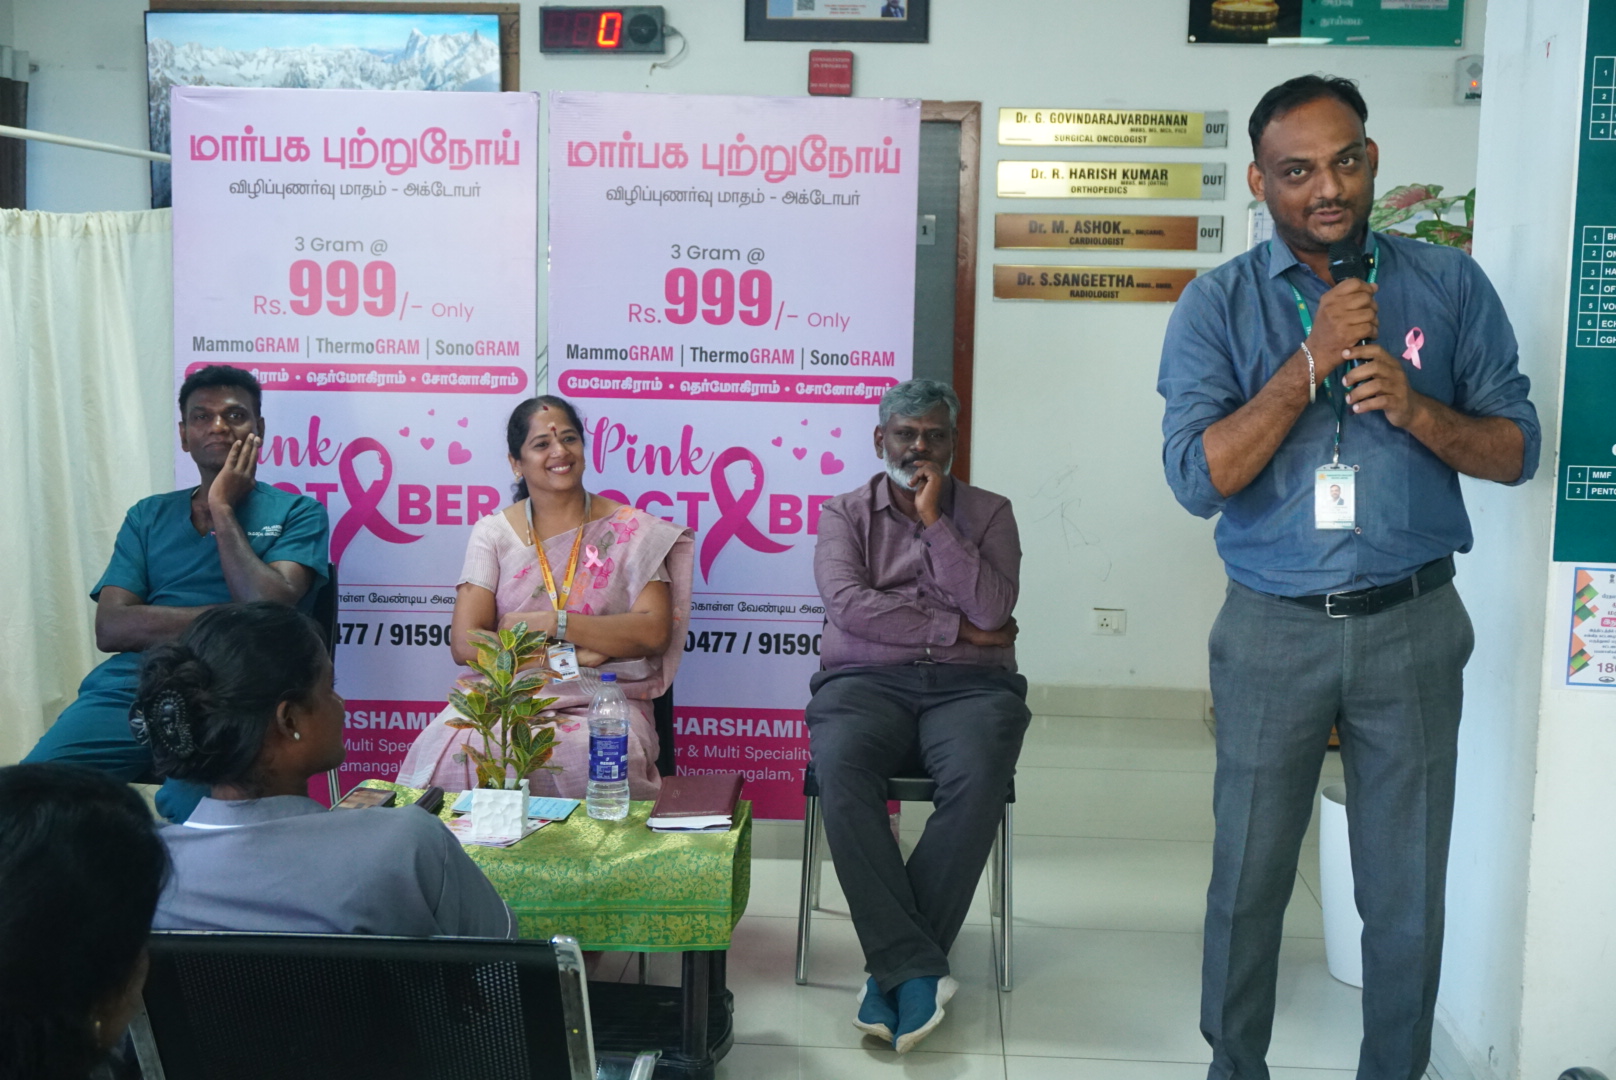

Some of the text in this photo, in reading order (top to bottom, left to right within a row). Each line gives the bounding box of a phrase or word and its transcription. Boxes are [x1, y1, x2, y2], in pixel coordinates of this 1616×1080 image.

[597, 12, 622, 48] 0
[1015, 112, 1188, 126] Dr. G. GOVINDARAJVARDHANAN
[1205, 124, 1225, 134] OUT
[1054, 134, 1148, 143] SURGICAL ONCOLOGIST
[190, 125, 520, 176] மார்பக புற்றுநோய்
[567, 130, 901, 184] மார்பக புற்றுநோய்
[1031, 168, 1168, 180] Dr. R. HARISH KUMAR
[1203, 175, 1223, 185] OUT
[229, 179, 335, 200] விழிப்புணர்வு
[339, 180, 387, 199] மாதம்
[403, 180, 481, 198] அக்டோபர்
[606, 185, 713, 207] விழிப்புணர்வு
[717, 187, 765, 208] மாதம்
[782, 189, 861, 207] அக்டோபர்
[1070, 186, 1128, 194] ORTHOPEDICS
[922, 225, 928, 235] 1
[1028, 220, 1047, 234] Dr.
[1052, 221, 1069, 234] M.
[1074, 221, 1121, 235] ASHOK
[1200, 228, 1220, 238] OUT
[294, 236, 388, 256] 3 Gram @
[1069, 237, 1125, 246] CARDIOLOGIST
[671, 244, 765, 265] 3 Gram @
[1017, 272, 1036, 286] Dr.
[1069, 290, 1120, 299] RADIOLOGIST
[431, 301, 474, 323] Only
[1602, 302, 1616, 310] VO
[807, 312, 851, 333] Only
[192, 336, 520, 357] MammoGRAM ThermoGRAM SonoGRAM
[566, 344, 895, 367] MammoGRAM ThermoGRAM SonoGRAM
[306, 370, 407, 388] தெர்மோகிராம்
[421, 372, 519, 389] சோனோகிராம்
[567, 376, 663, 393] மேமோகிராம்
[680, 378, 781, 396] தெர்மோகிராம்
[585, 416, 714, 476] Pink
[1592, 471, 1612, 479] MMF
[368, 592, 427, 606] வேண்டிய
[737, 601, 796, 615] வேண்டிய
[1597, 663, 1616, 674] 18
[687, 744, 699, 758] &
[704, 745, 740, 759] Multi
[745, 746, 812, 762] Speciality
